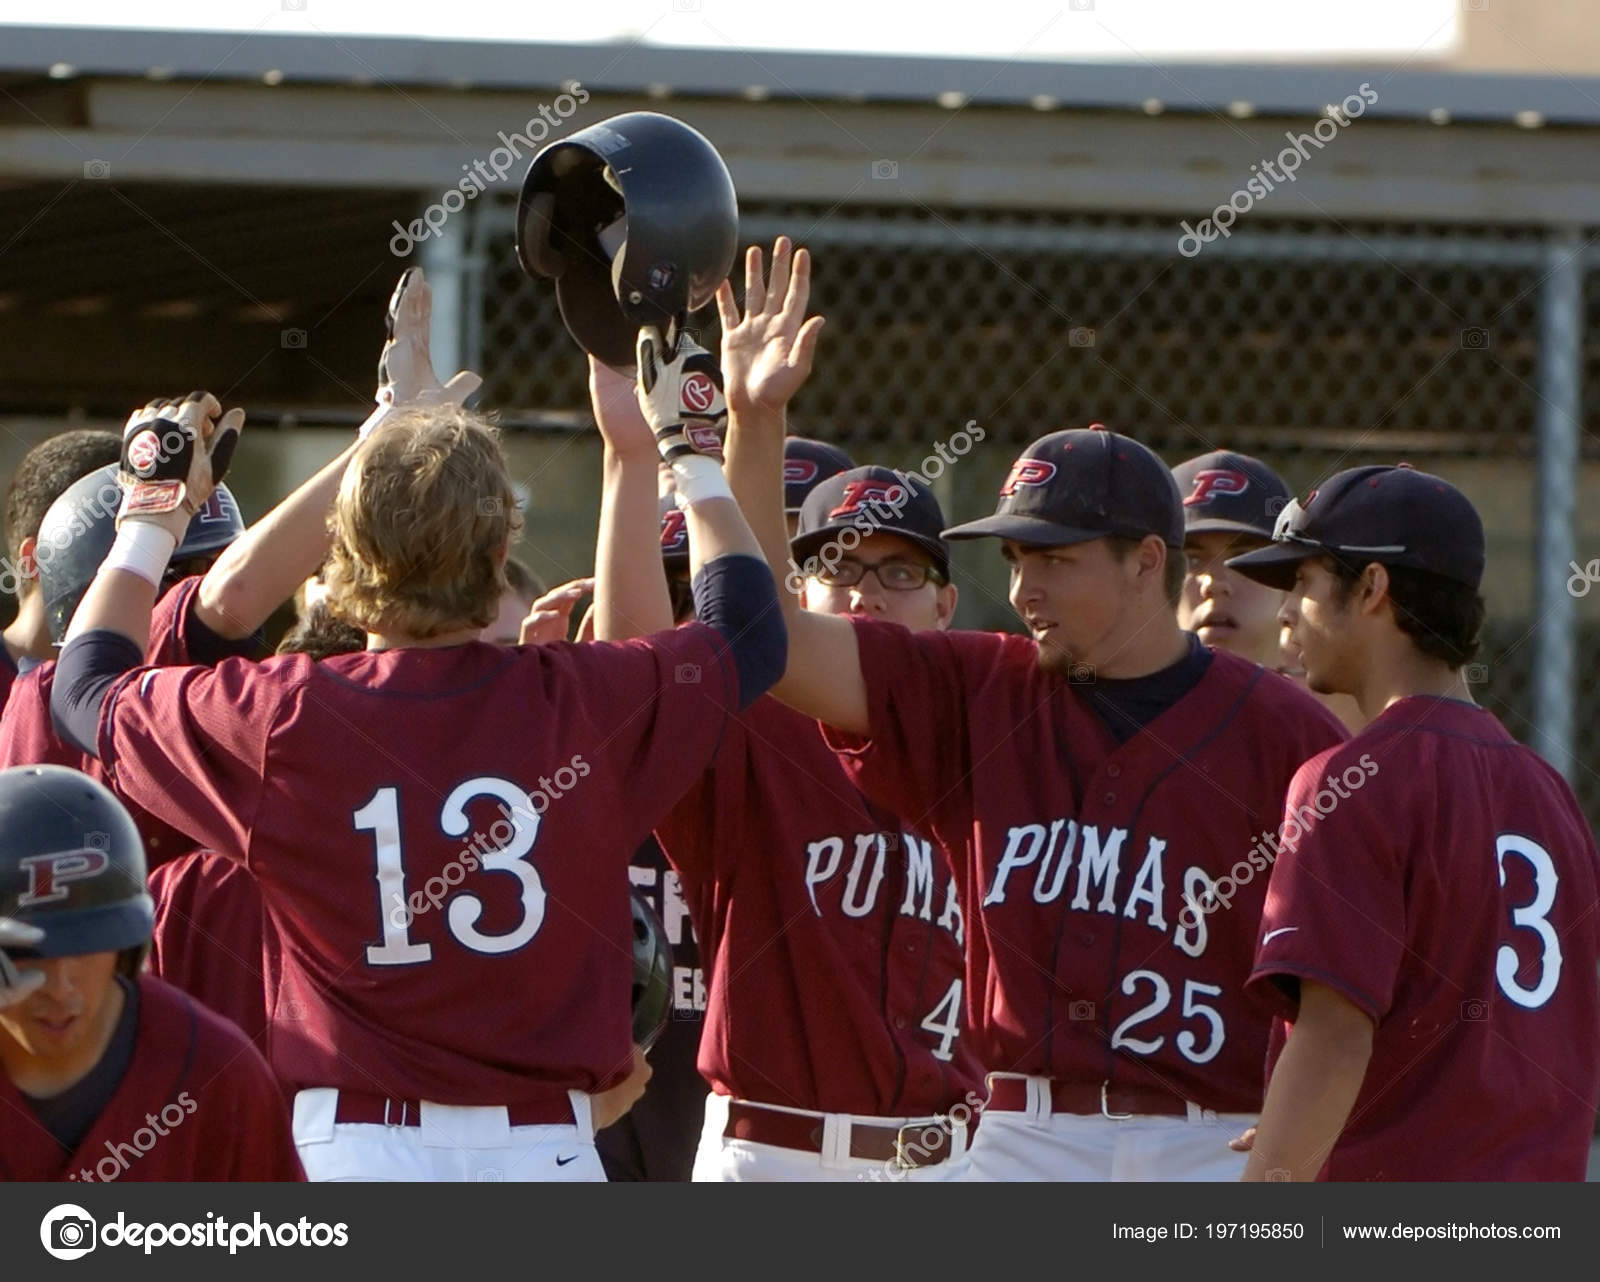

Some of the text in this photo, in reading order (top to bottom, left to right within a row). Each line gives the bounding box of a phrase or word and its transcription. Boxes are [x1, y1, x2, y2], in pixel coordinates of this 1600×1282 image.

[1000, 458, 1057, 498] P
[1182, 469, 1249, 507] P
[19, 847, 109, 906] P
[354, 777, 547, 966] 13
[806, 832, 968, 962] PUMA
[983, 819, 1216, 958] PUMAS
[1496, 835, 1562, 1009] 3
[921, 978, 963, 1061] 4
[1111, 969, 1226, 1064] 25
